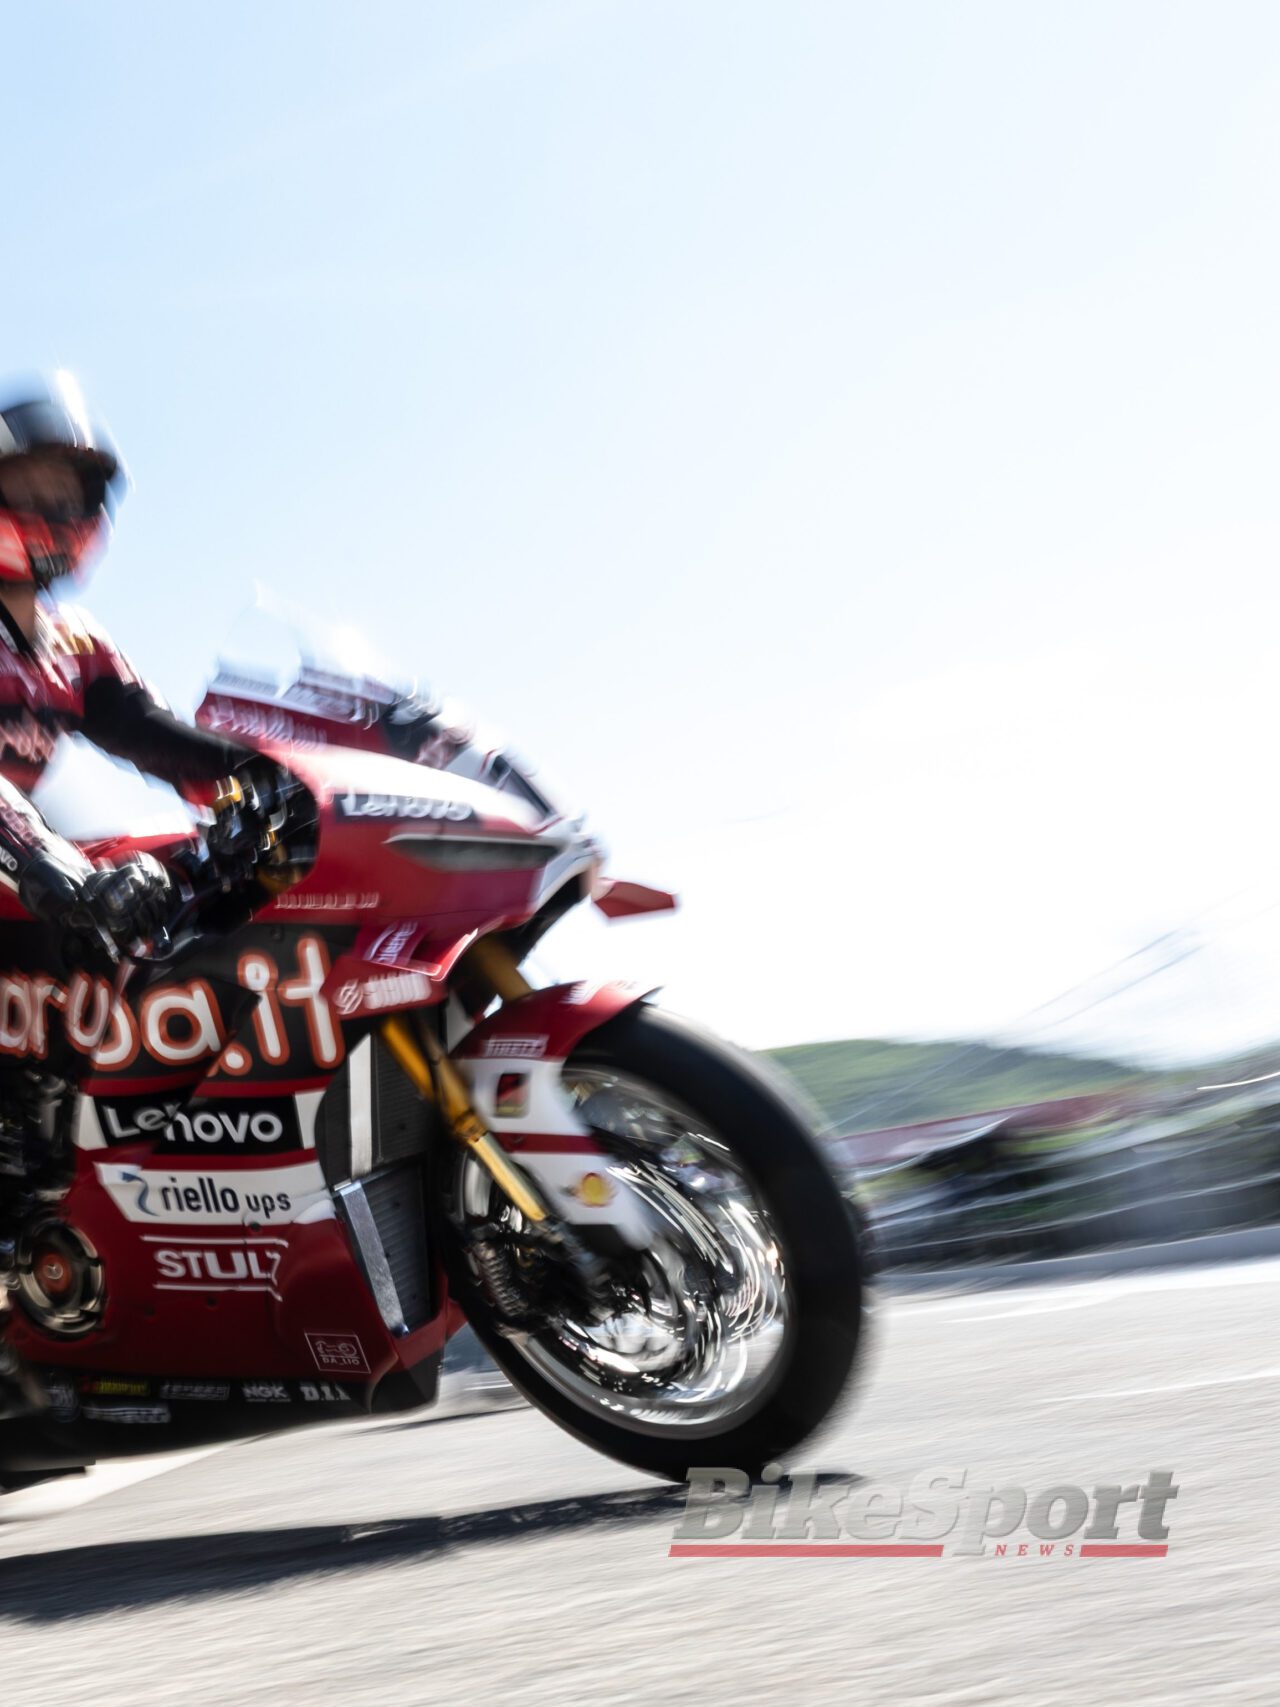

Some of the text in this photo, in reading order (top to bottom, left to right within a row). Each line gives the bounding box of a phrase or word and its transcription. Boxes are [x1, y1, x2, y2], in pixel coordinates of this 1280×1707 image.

[103, 1105, 284, 1144] Lenovo
[161, 1177, 291, 1218] riello ups
